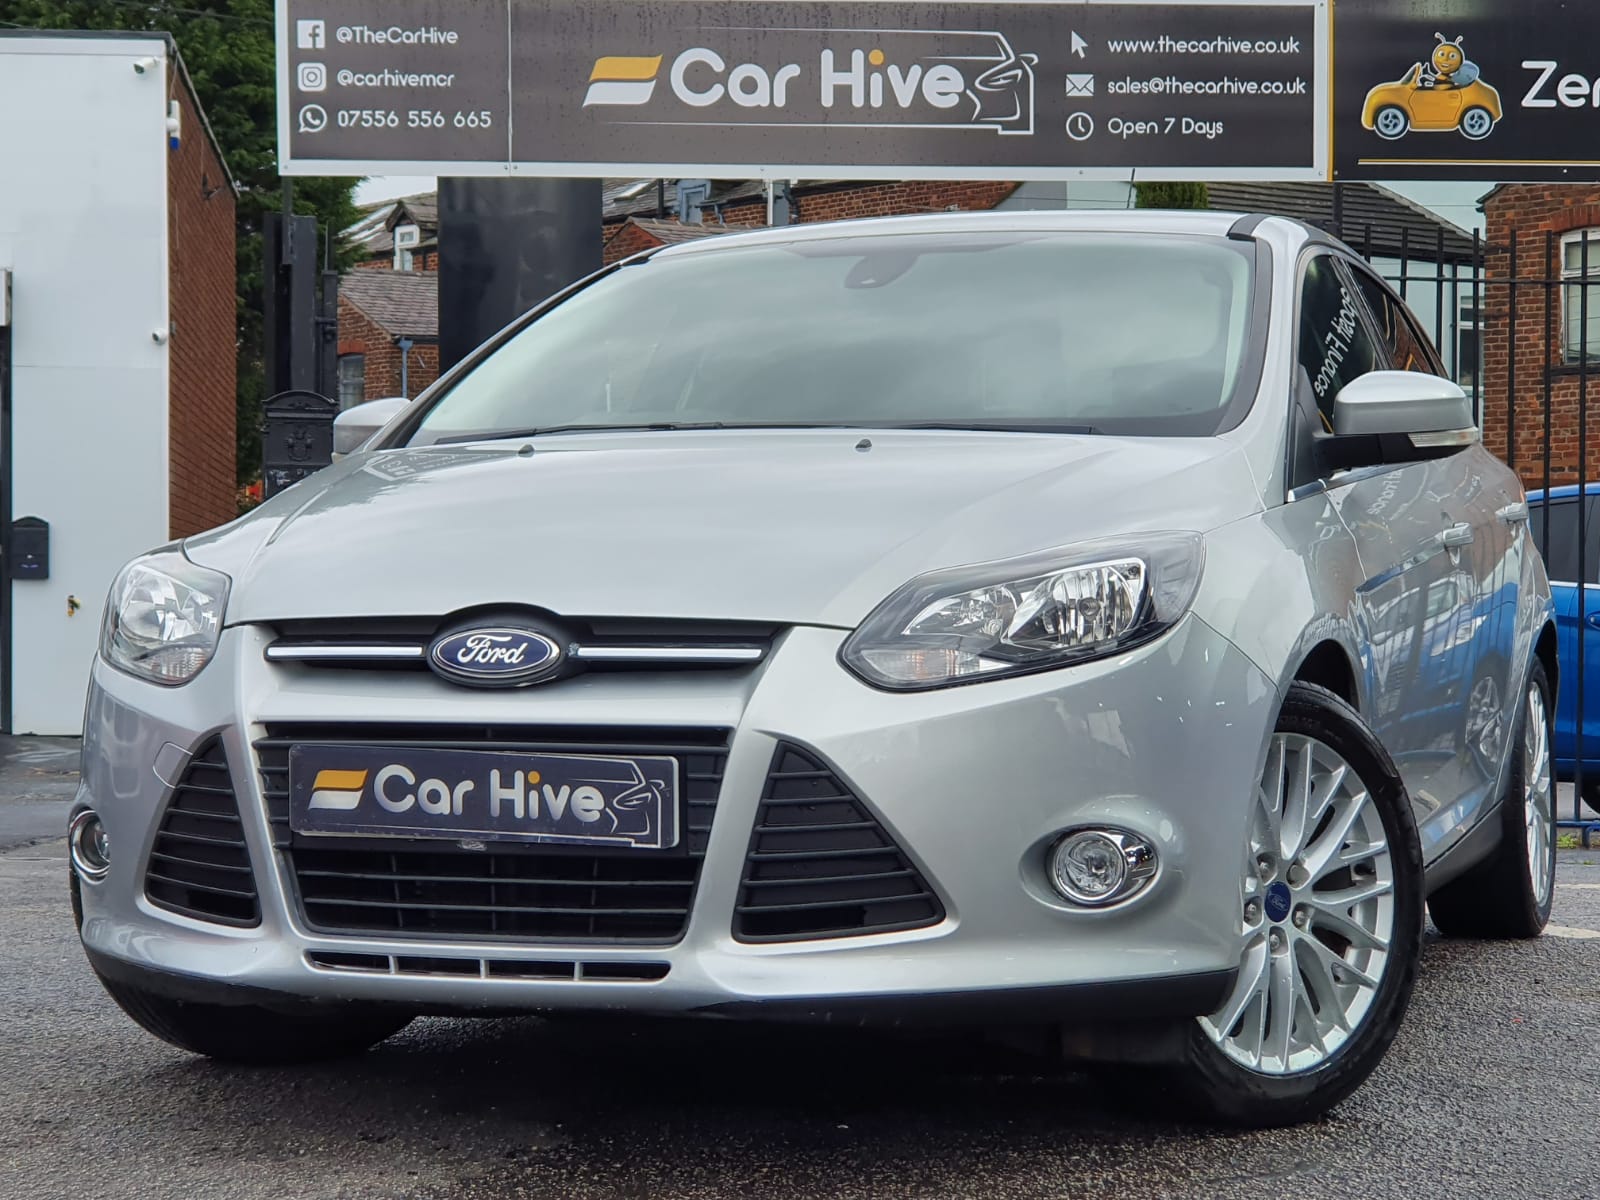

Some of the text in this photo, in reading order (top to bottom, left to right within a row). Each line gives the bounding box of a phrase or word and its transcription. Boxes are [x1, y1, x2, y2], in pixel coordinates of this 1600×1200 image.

[336, 25, 459, 45] @TheCarHive
[1107, 35, 1300, 54] www.thecarhive.co.uk
[336, 68, 455, 88] @carhivemcr
[670, 47, 965, 108] Car Hive
[1107, 76, 1306, 95] sales@thecarhive.co.uk
[337, 110, 492, 128] 07556 556 665
[1107, 117, 1224, 139] Open 7 Days
[457, 634, 528, 665] Ford
[373, 764, 606, 823] Car Hive
